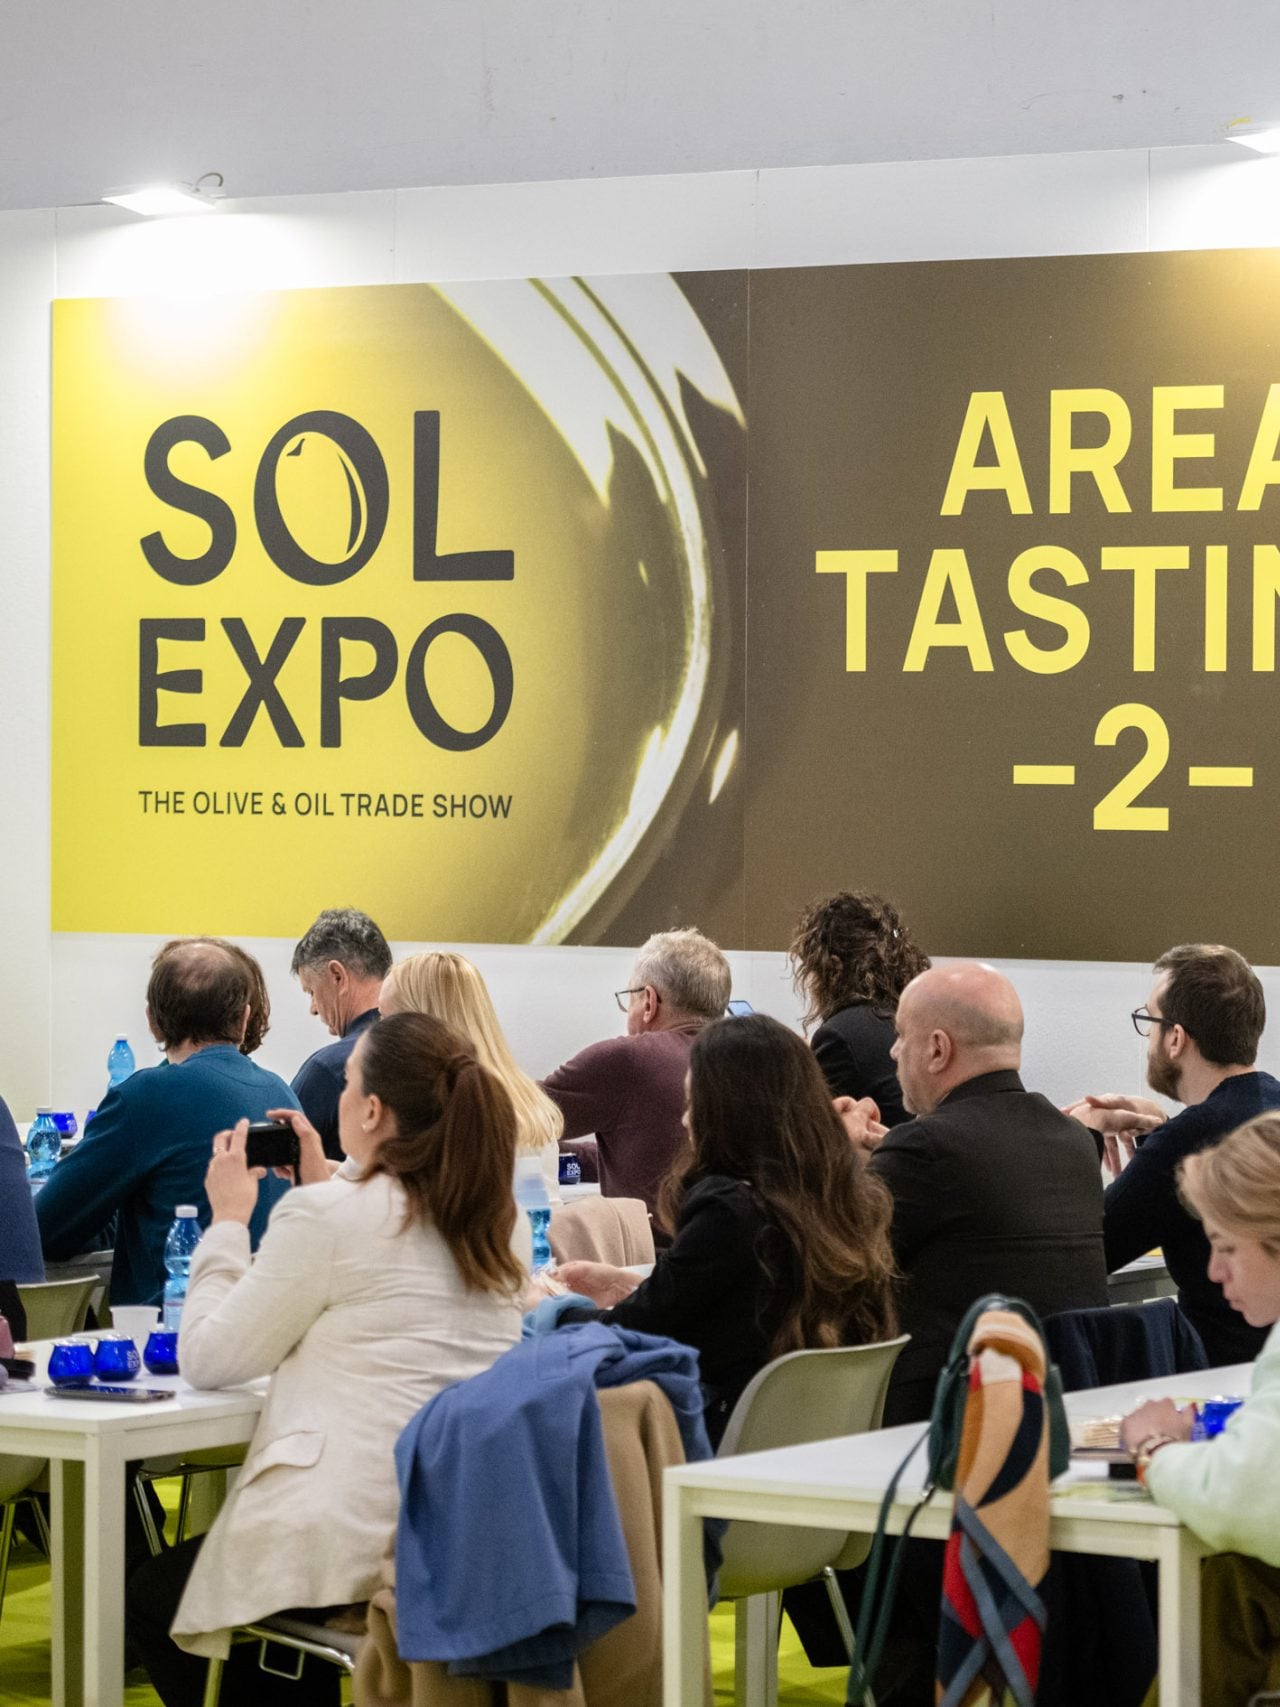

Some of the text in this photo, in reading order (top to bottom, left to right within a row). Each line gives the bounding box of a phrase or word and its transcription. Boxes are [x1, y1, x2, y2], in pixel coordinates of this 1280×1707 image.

[140, 410, 515, 586] SOL
[138, 613, 514, 752] EXPO
[137, 790, 513, 819] THE OLIVE & OIL TRADE SHOW
